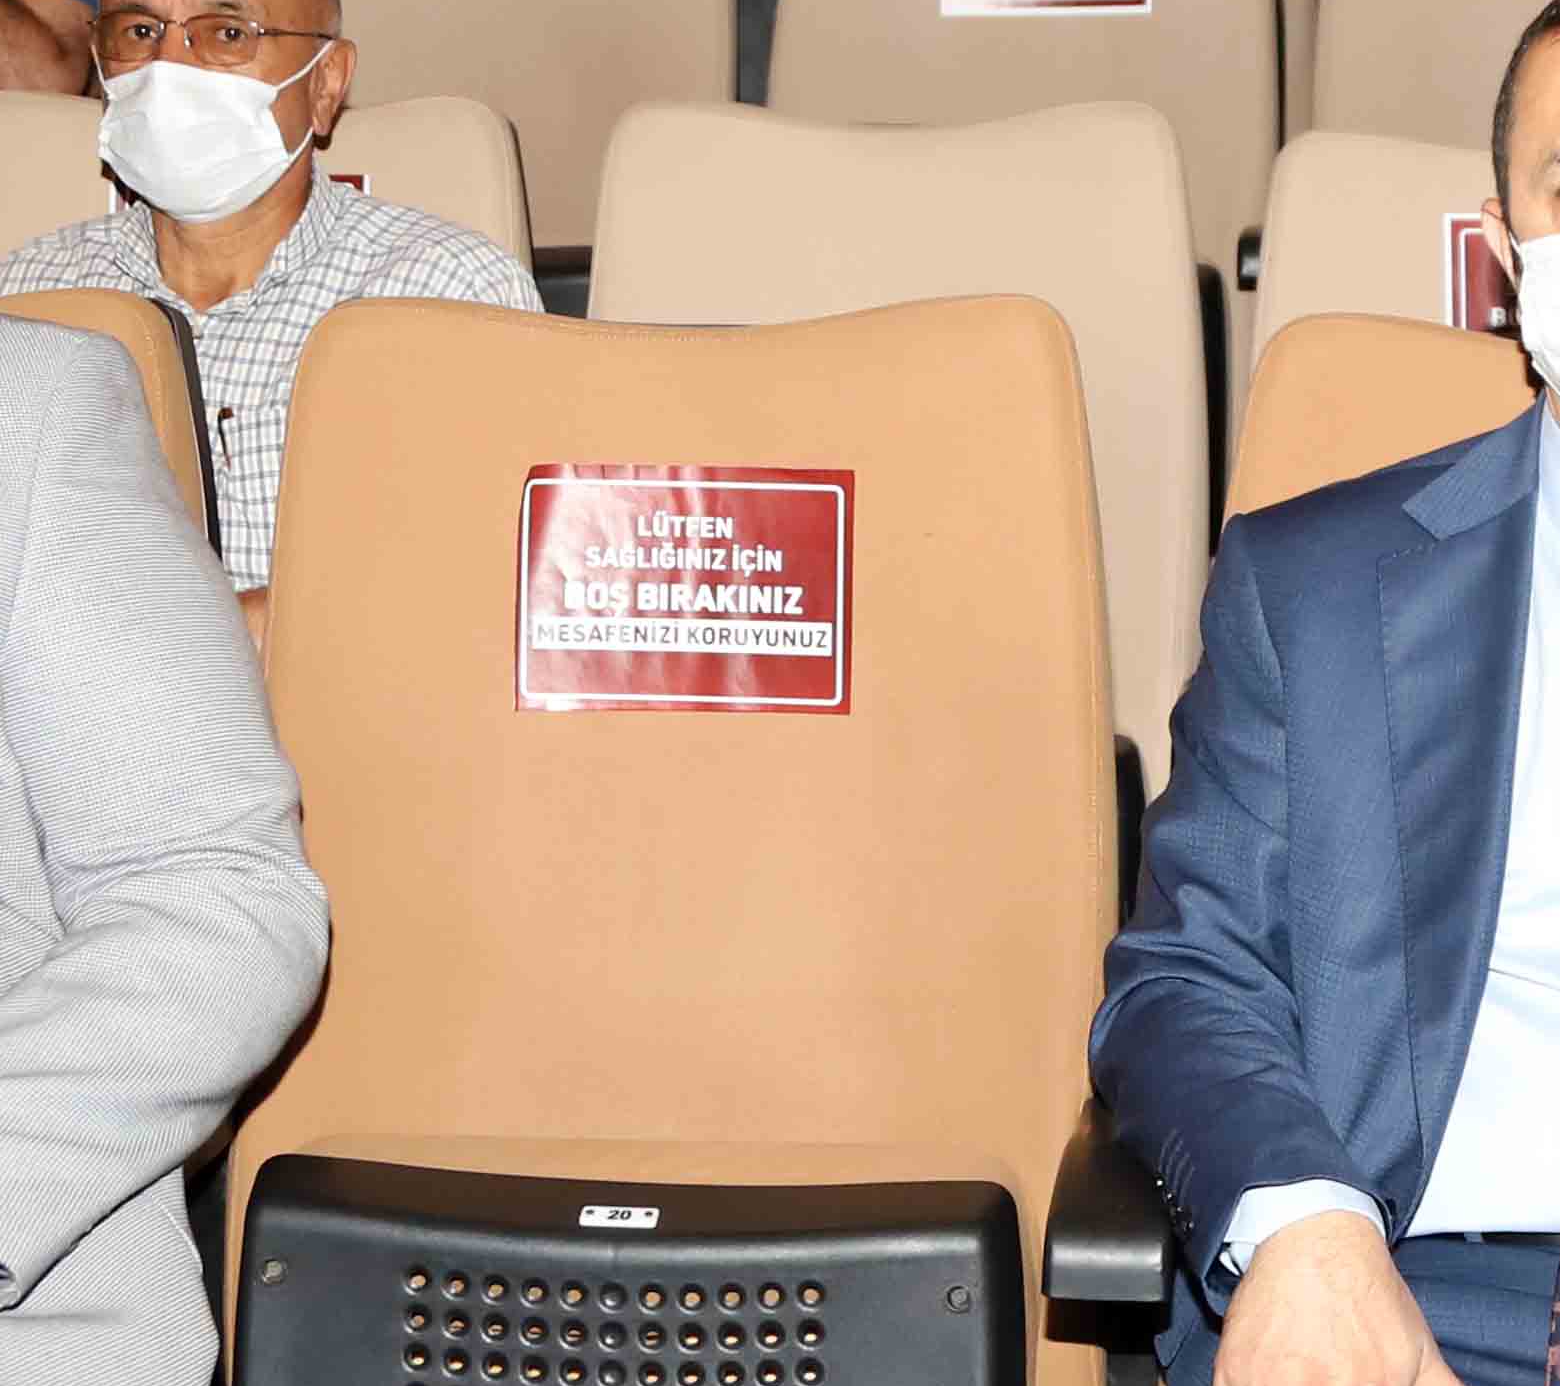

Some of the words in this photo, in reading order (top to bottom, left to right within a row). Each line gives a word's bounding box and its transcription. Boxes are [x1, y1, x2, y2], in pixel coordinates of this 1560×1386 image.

[637, 511, 733, 539] LÜTFEN
[584, 543, 727, 571] SAĞLIĞINIZ
[731, 545, 783, 577] İÇİN
[563, 580, 630, 618] BOŞ
[637, 583, 803, 615] BIRAKINIZ
[538, 621, 679, 644] MESAFENİZİ
[687, 626, 827, 648] KORUYUNUZ
[607, 1208, 632, 1221] 20
